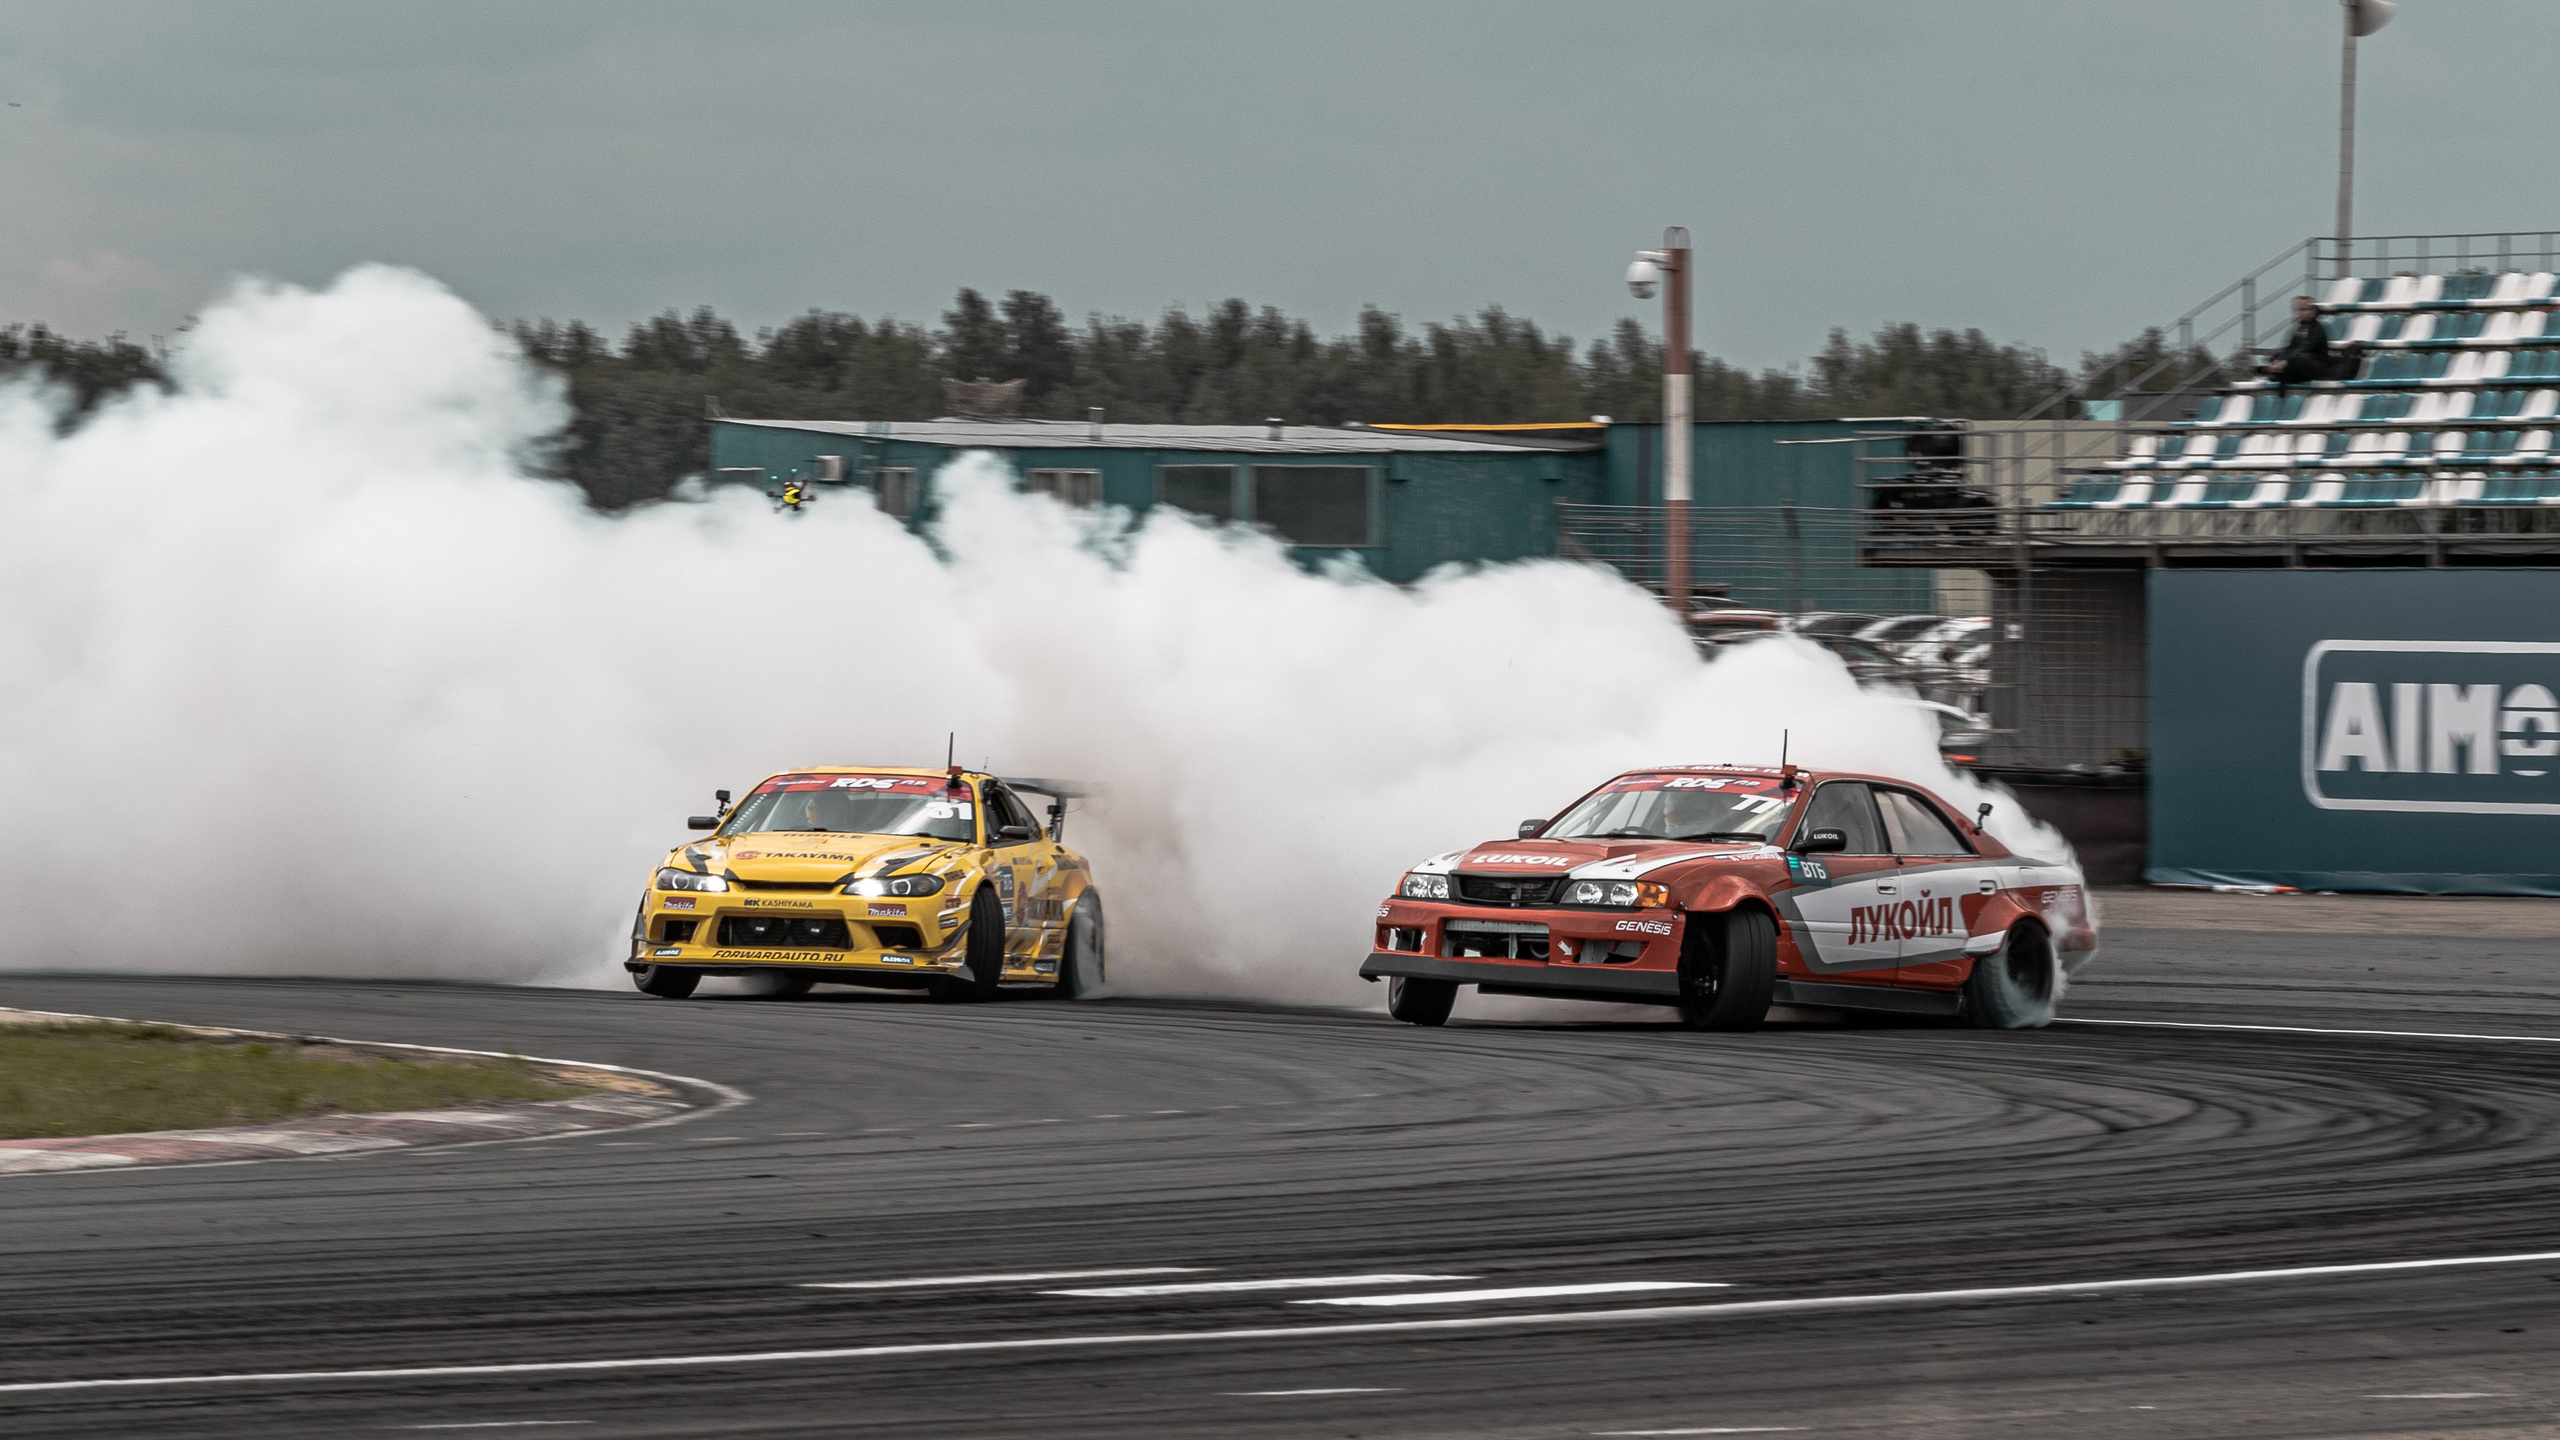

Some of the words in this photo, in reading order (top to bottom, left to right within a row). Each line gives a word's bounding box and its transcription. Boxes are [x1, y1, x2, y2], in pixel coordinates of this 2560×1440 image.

[1763, 767, 1810, 778] TEM
[829, 778, 900, 789] RDS
[1664, 777, 1736, 789] RDS
[1731, 794, 1783, 814] 77
[926, 802, 973, 820] 31
[764, 852, 855, 862] TAKAYAMA
[1472, 854, 1570, 867] LUKOIL
[1800, 861, 1827, 879] ВТБ
[663, 901, 695, 911] makita
[762, 900, 813, 909] KASHIYAMA
[868, 907, 906, 918] makita
[1848, 889, 1954, 946] ЛУКОЙЛ
[1615, 920, 1672, 936] GENESIS
[712, 950, 845, 962] FORWARDAUTO.RU
